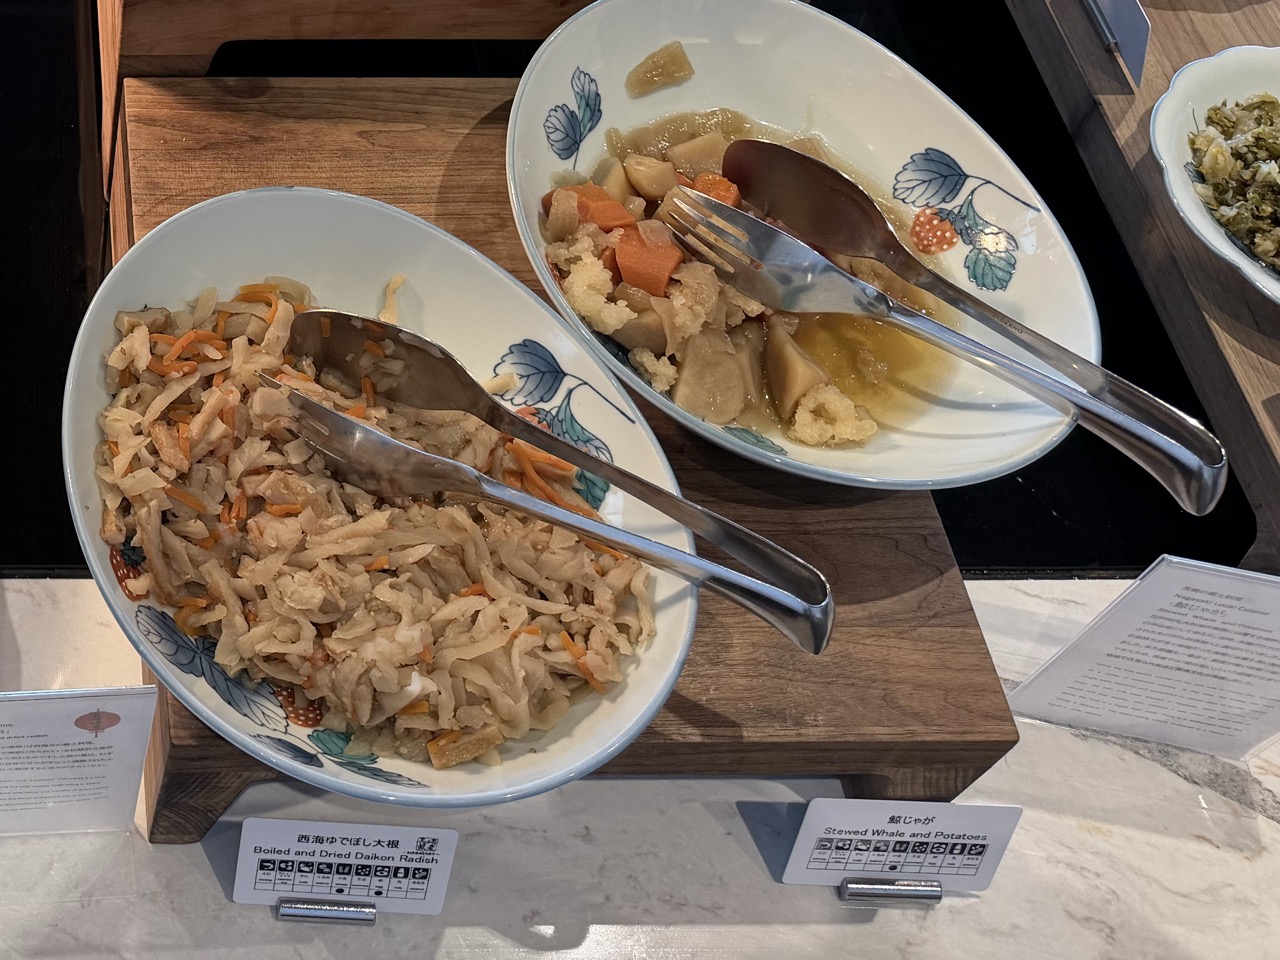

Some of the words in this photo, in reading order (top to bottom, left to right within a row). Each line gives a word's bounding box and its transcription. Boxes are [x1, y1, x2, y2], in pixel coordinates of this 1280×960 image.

[1174, 594, 1213, 604] Nagasaki
[887, 815, 935, 825] 鯨じゃが
[824, 827, 868, 835] Stewed
[934, 831, 986, 840] Potatoes
[297, 834, 400, 848] 西海ゆでぼし大根
[253, 846, 290, 855] Boiled
[319, 850, 350, 858] Dried
[355, 852, 394, 861] Daikon
[399, 852, 438, 863] Radish
